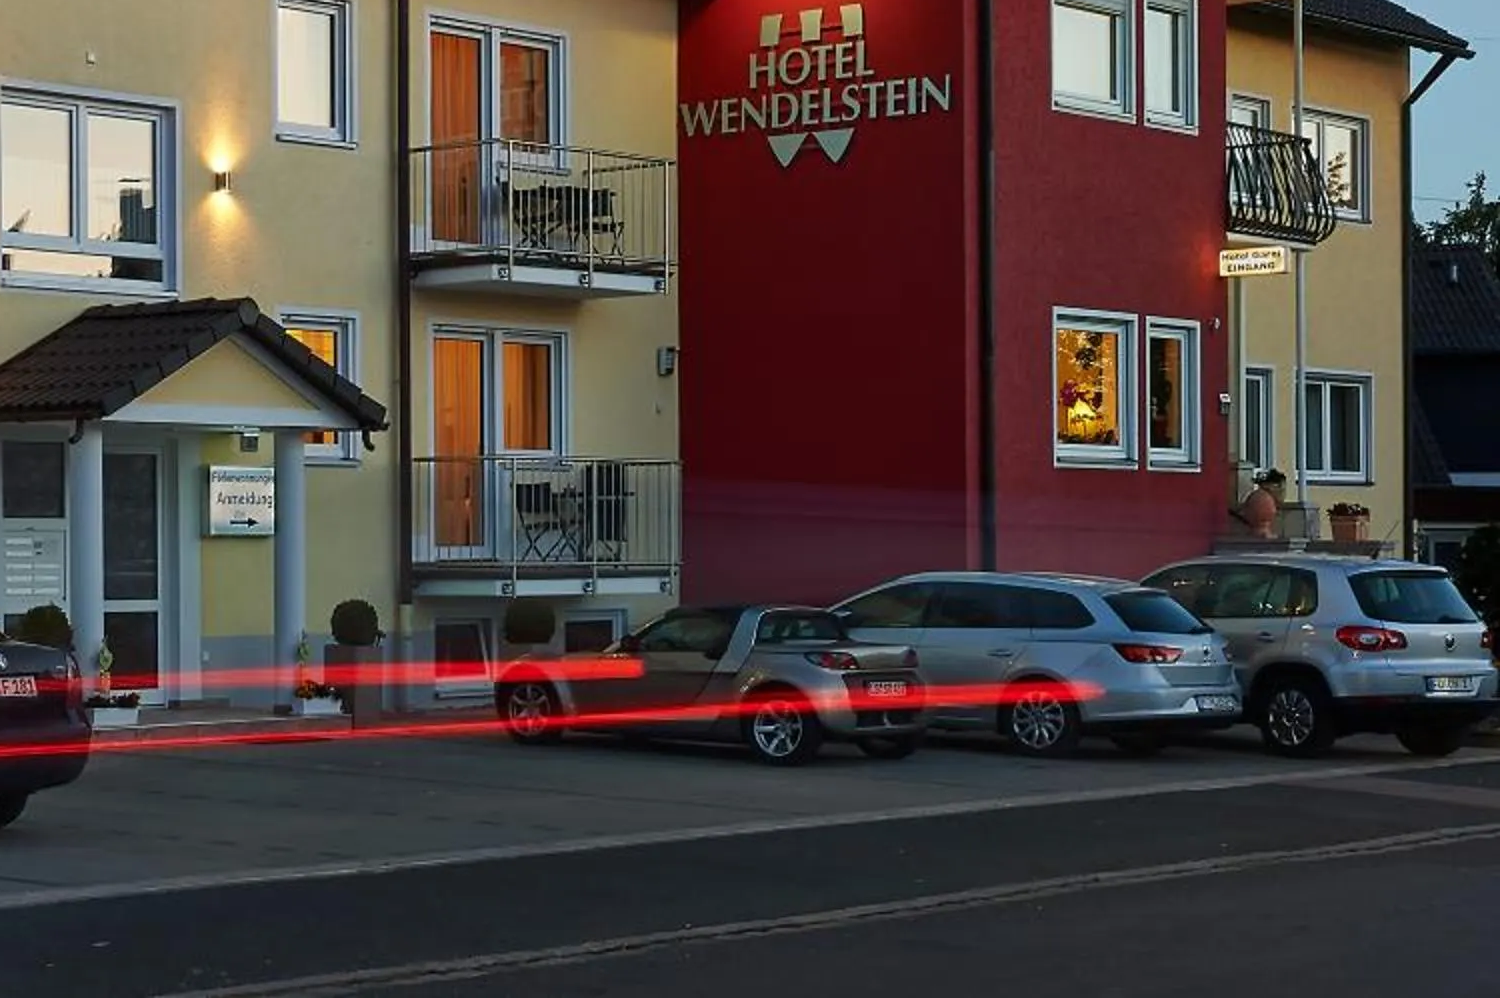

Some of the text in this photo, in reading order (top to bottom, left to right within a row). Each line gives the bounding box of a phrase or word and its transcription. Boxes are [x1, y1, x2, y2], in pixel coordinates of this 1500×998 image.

[749, 40, 875, 89] HOTEL
[679, 74, 951, 137] WENDELSTEIN
[1227, 262, 1275, 272] EINGANG
[217, 491, 273, 509] Anmeldung
